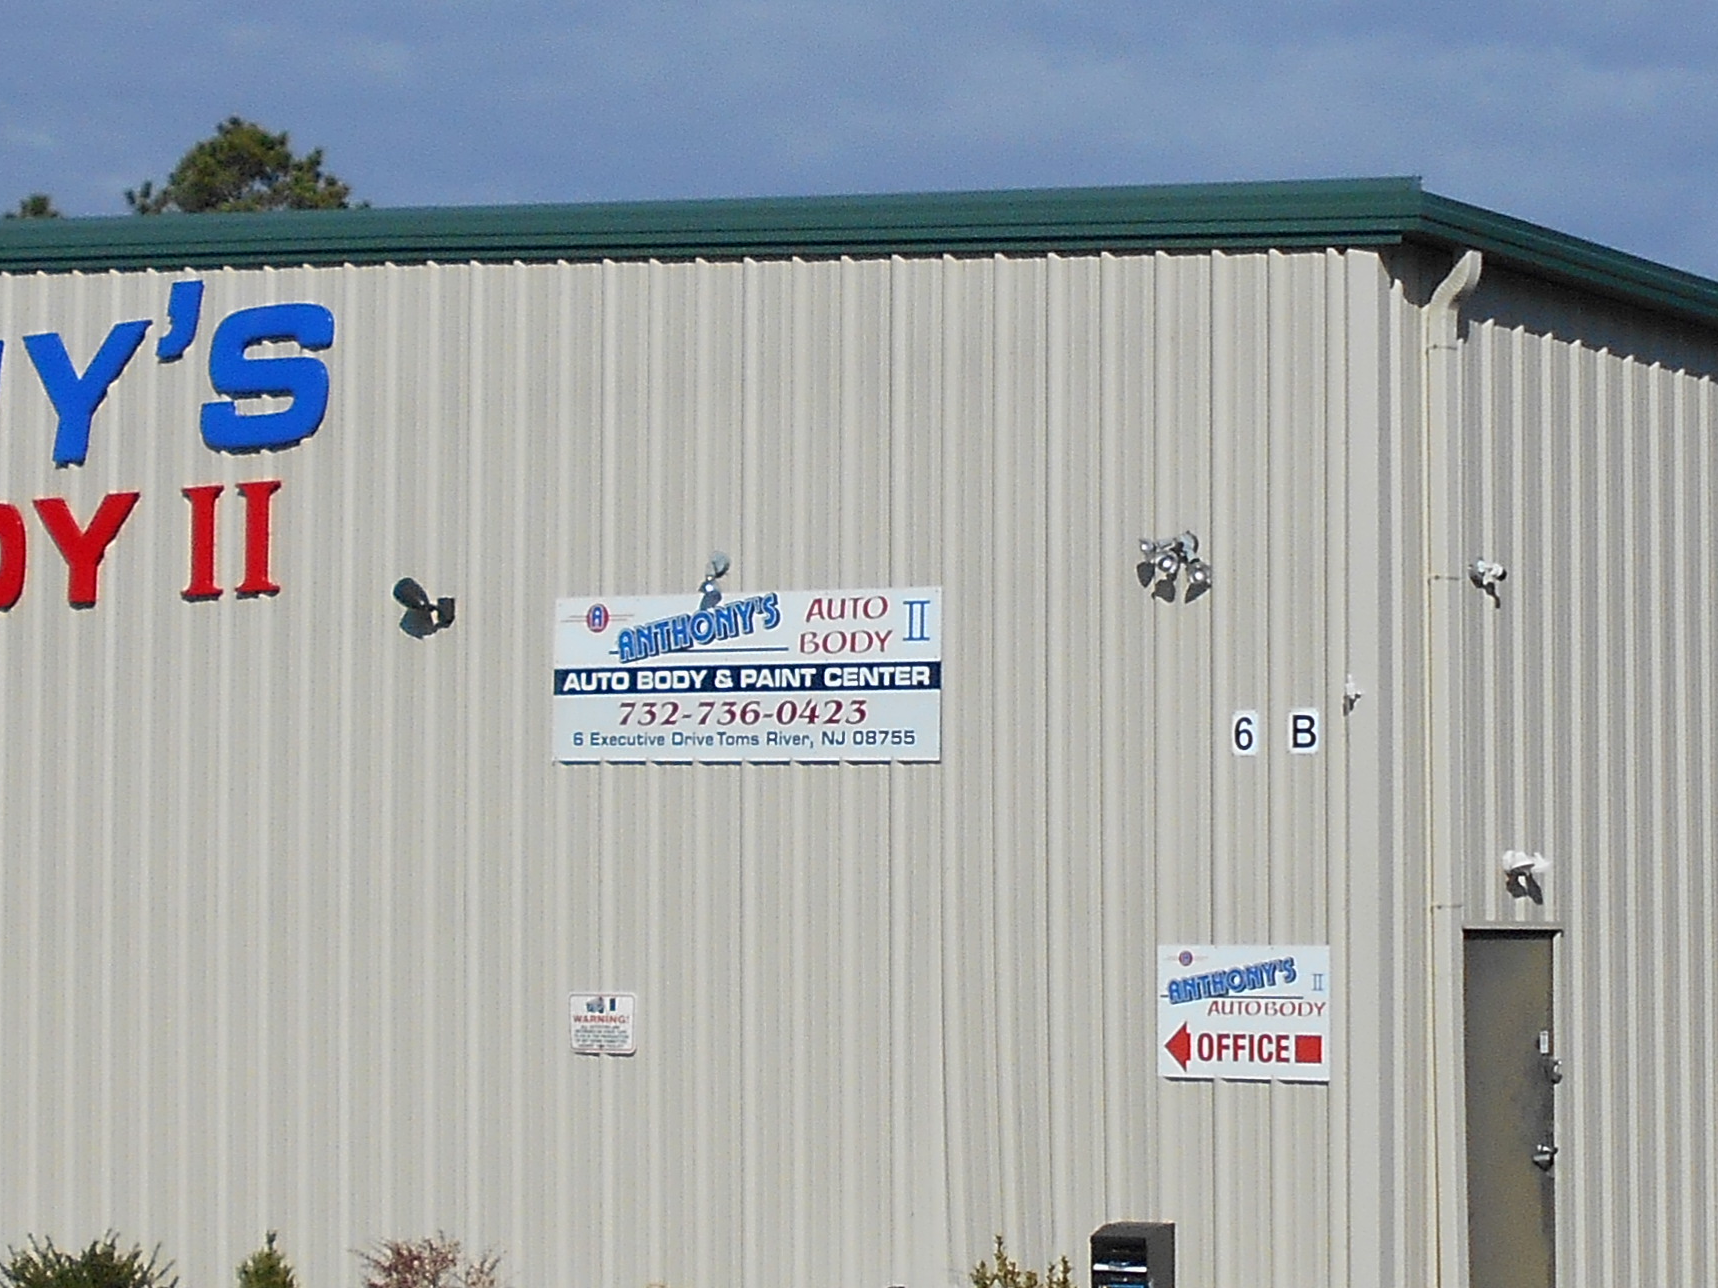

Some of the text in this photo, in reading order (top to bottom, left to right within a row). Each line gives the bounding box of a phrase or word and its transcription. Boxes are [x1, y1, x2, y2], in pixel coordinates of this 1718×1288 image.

[181, 480, 281, 601] II
[617, 592, 781, 663] ANTHONY'S
[805, 596, 931, 642] AUTO II
[799, 629, 893, 655] BODY
[562, 665, 931, 692] AUTO BODY & PAINT CENTER
[618, 698, 868, 727] 732-736-0423
[572, 730, 916, 749] 6 Executive Drive Toms River, NJ 08755
[1233, 714, 1317, 751] 6 B
[1168, 956, 1297, 1005] ANTHONY'S
[1197, 1032, 1290, 1063] OFFICE
